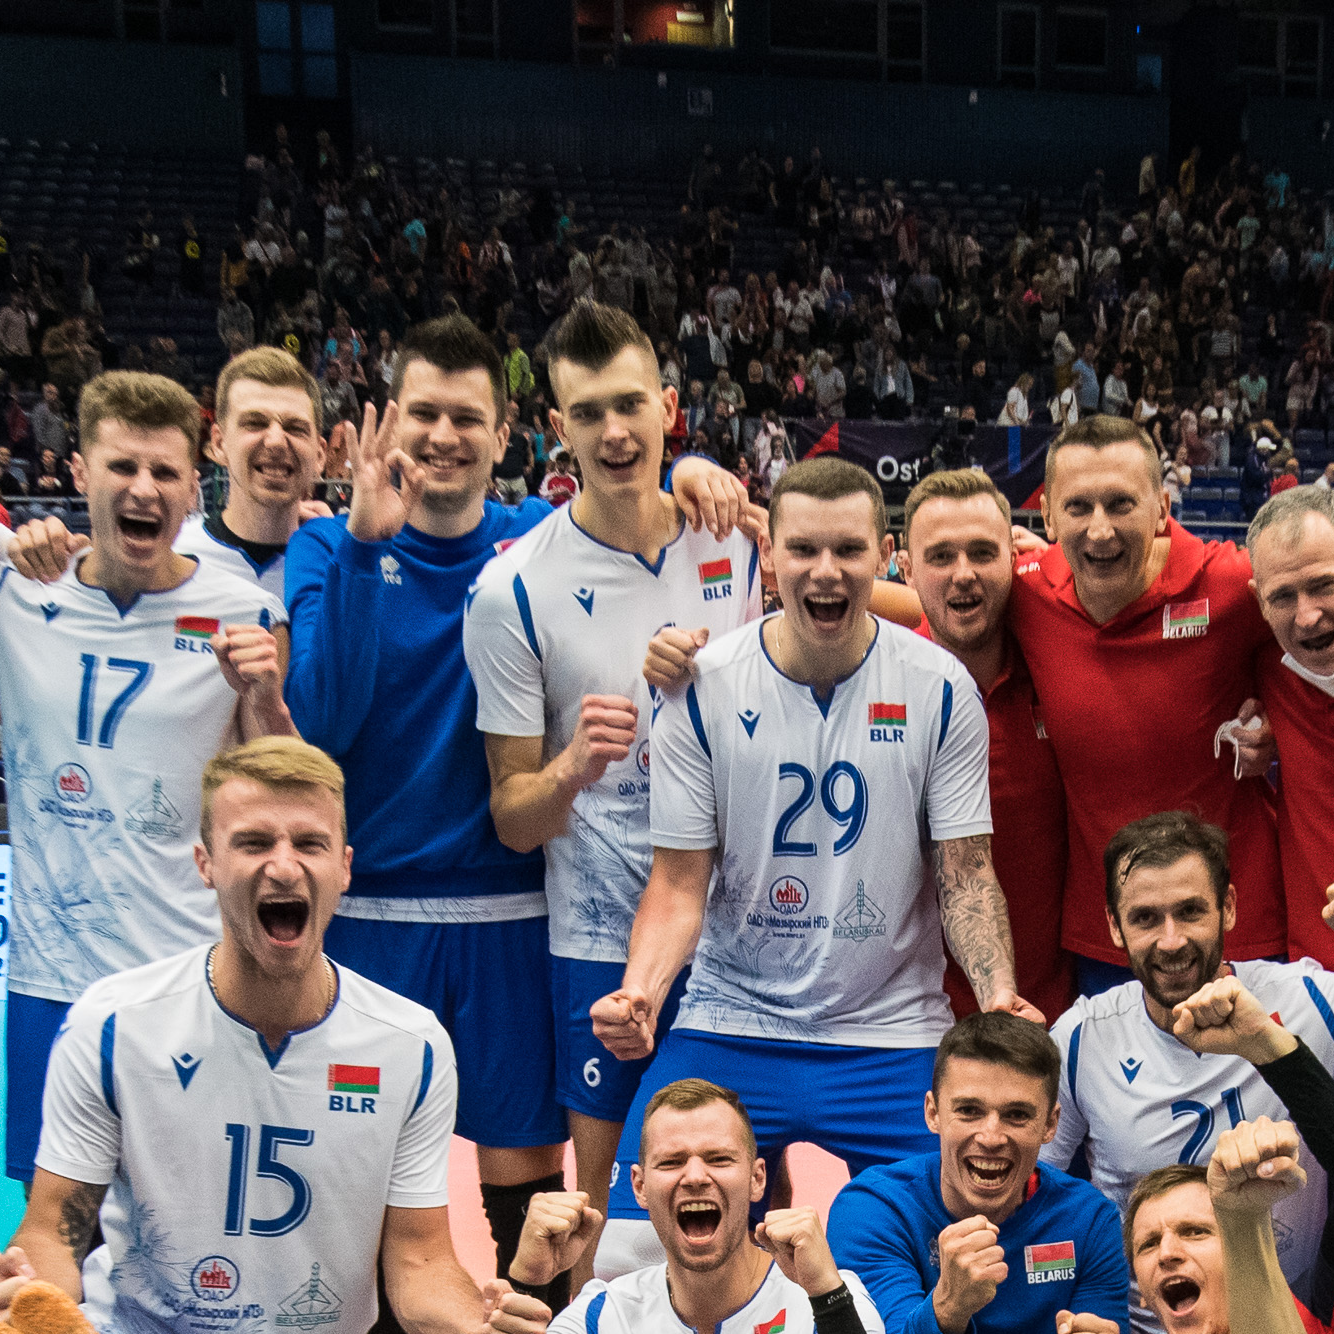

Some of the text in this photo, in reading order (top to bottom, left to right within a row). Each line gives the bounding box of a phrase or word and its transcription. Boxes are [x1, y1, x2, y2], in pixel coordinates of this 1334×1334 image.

[703, 584, 732, 601] BLR
[174, 637, 212, 654] BLR
[76, 652, 155, 749] 17
[870, 728, 905, 743] BLR
[772, 760, 869, 857] 29
[583, 1057, 602, 1088] 6
[328, 1095, 376, 1114] BLR
[224, 1122, 315, 1238] 15
[1027, 1268, 1076, 1284] BELARUS
